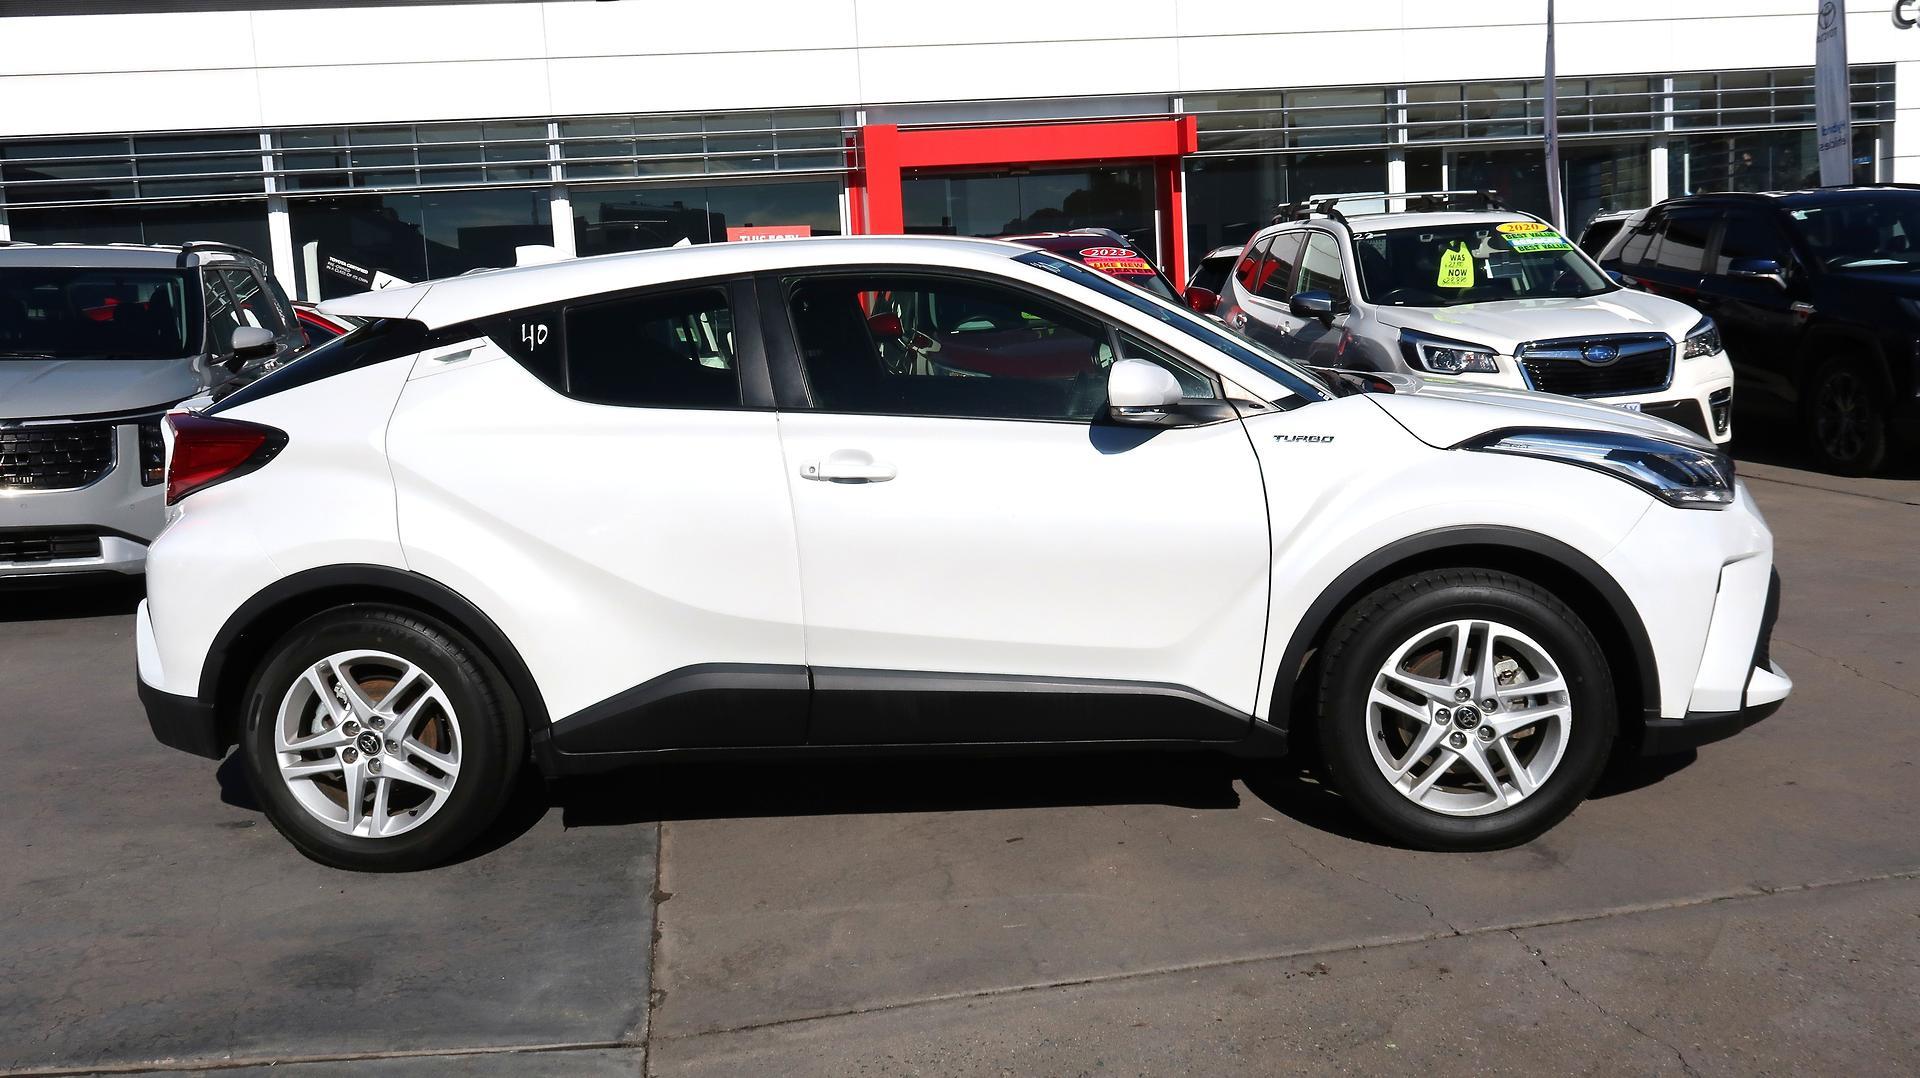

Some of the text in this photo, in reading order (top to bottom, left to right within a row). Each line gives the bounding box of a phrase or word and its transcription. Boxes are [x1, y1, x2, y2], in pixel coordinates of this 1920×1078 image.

[1892, 0, 1920, 30] C
[1508, 223, 1539, 232] 2020
[329, 256, 346, 266] TOYOTA
[1448, 269, 1468, 277] NOW
[521, 323, 548, 352] 40
[1273, 434, 1335, 443] TURBO
